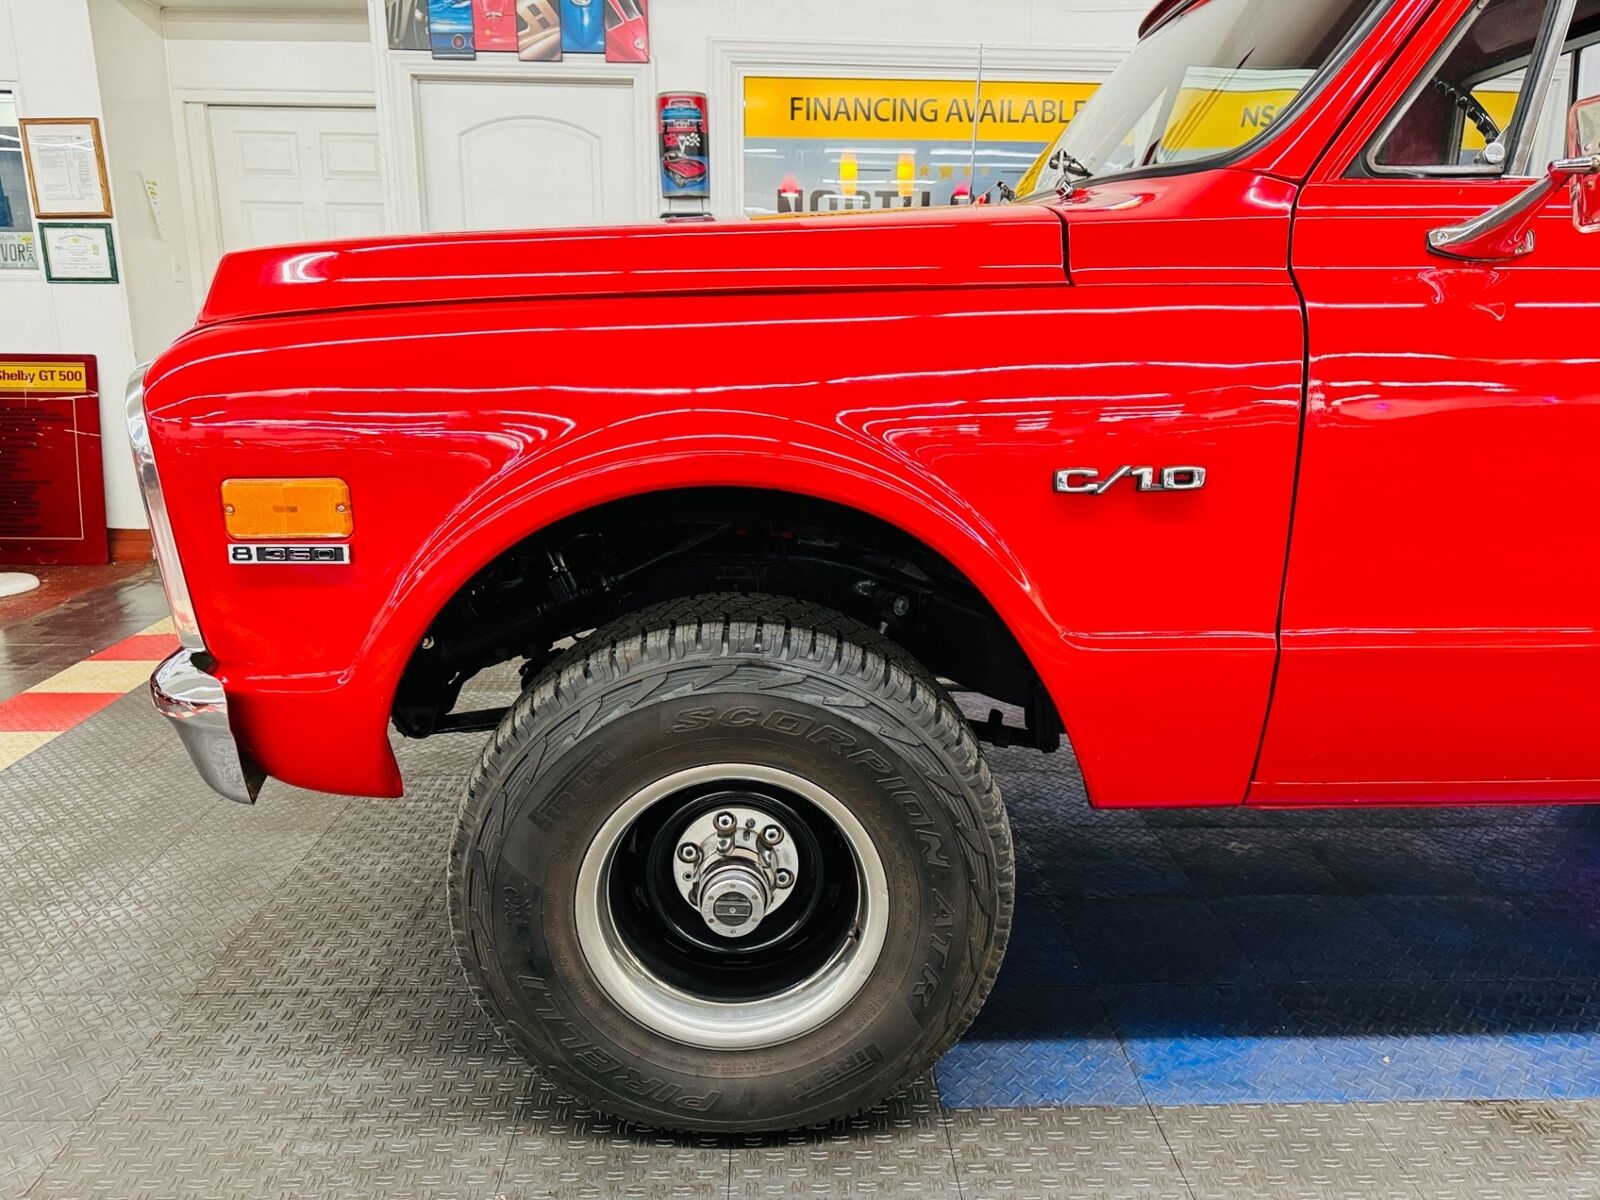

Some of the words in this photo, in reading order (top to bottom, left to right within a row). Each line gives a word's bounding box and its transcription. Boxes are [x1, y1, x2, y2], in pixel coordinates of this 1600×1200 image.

[790, 97, 938, 122] FINANCING
[39, 370, 56, 381] GT
[58, 370, 82, 381] 500
[1053, 464, 1207, 495] C/10
[232, 546, 253, 561] 8
[264, 547, 336, 561] 350
[665, 705, 952, 868] SCORPION
[911, 887, 956, 1008] ATR
[517, 974, 722, 1112] PIRELLI
